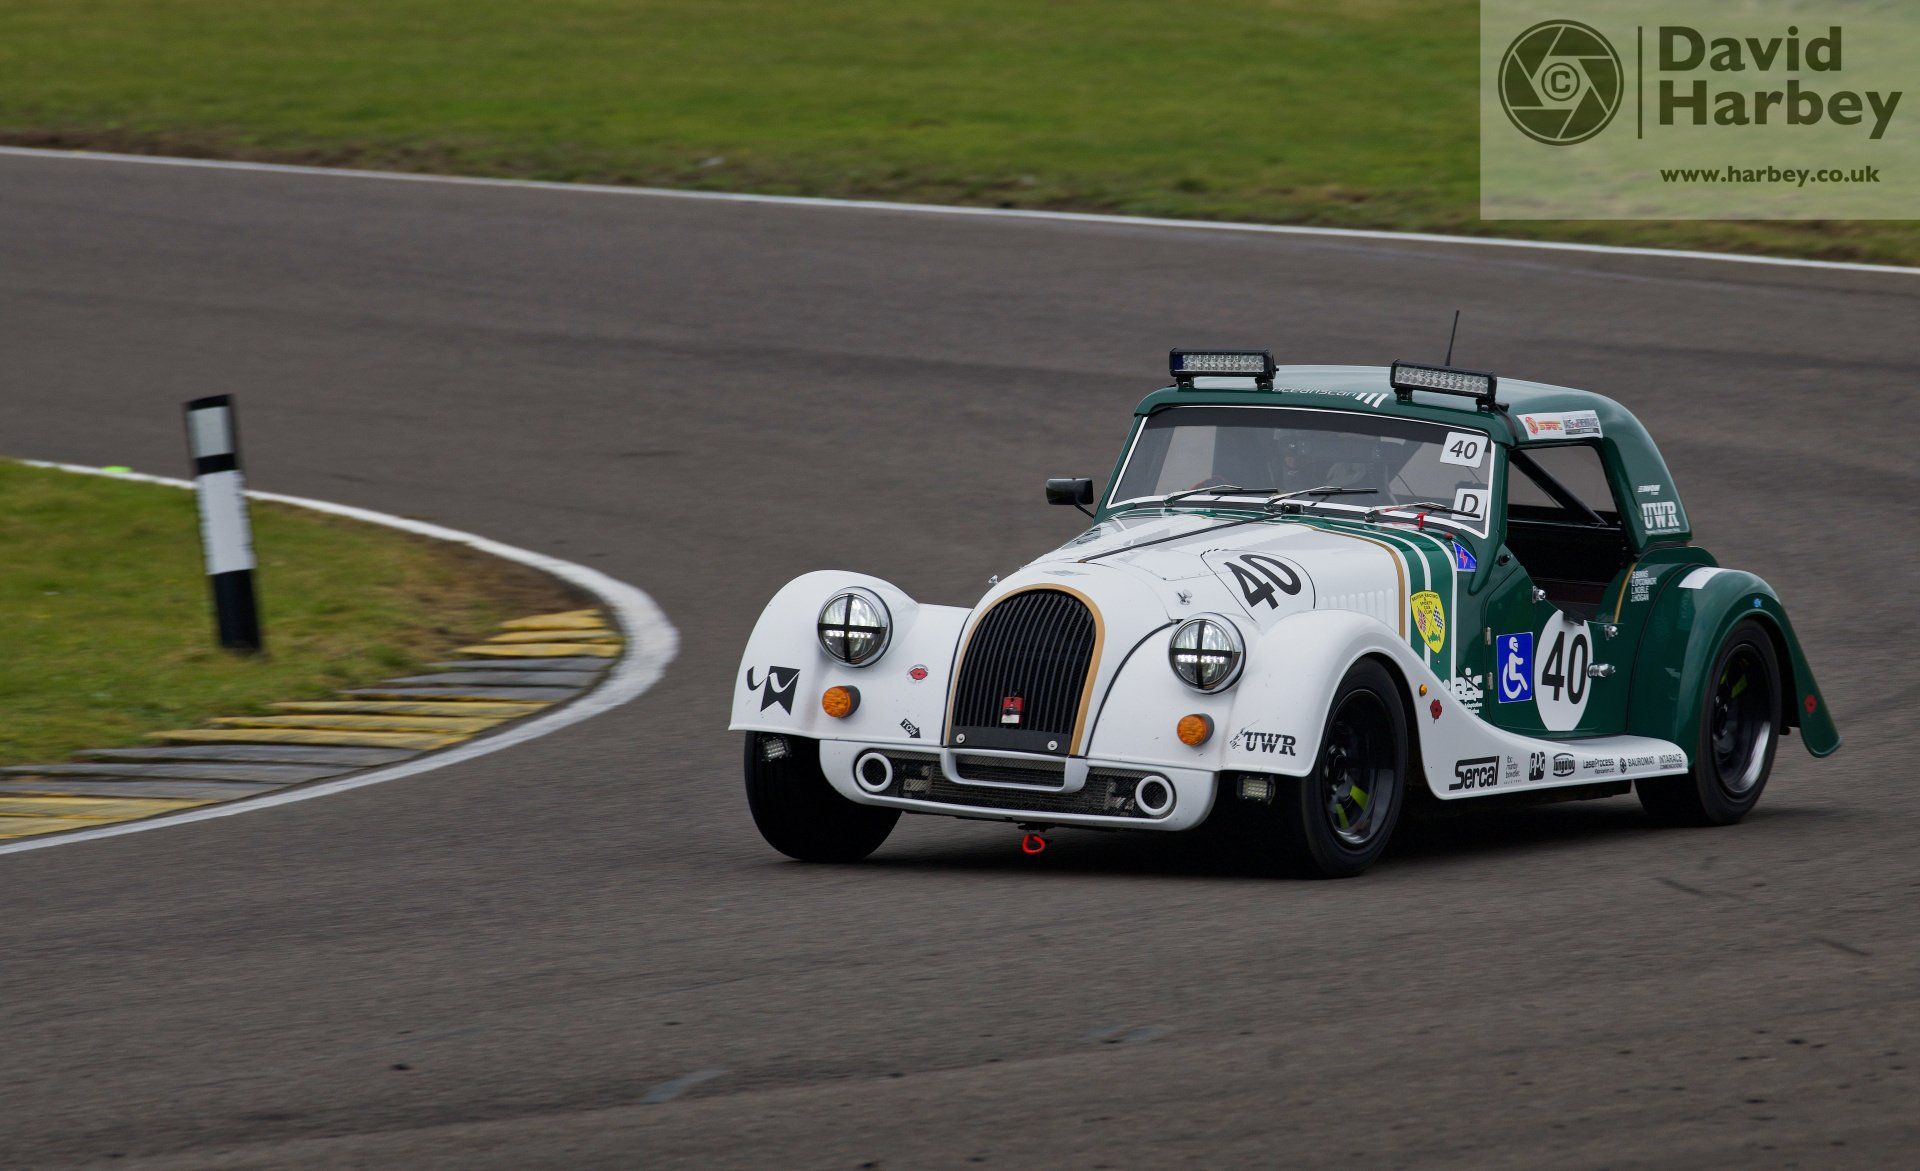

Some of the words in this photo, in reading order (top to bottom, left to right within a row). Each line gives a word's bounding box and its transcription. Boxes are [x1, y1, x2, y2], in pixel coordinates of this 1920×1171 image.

[1450, 440, 1478, 460] 40
[1461, 494, 1479, 513] D
[1641, 501, 1680, 529] UWR
[1223, 554, 1302, 610] 40
[1541, 631, 1588, 705] 40
[902, 720, 918, 736] TOW
[1244, 731, 1297, 757] UWR
[1449, 756, 1500, 791] Sercal
[1628, 756, 1655, 767] BAUROMAT
